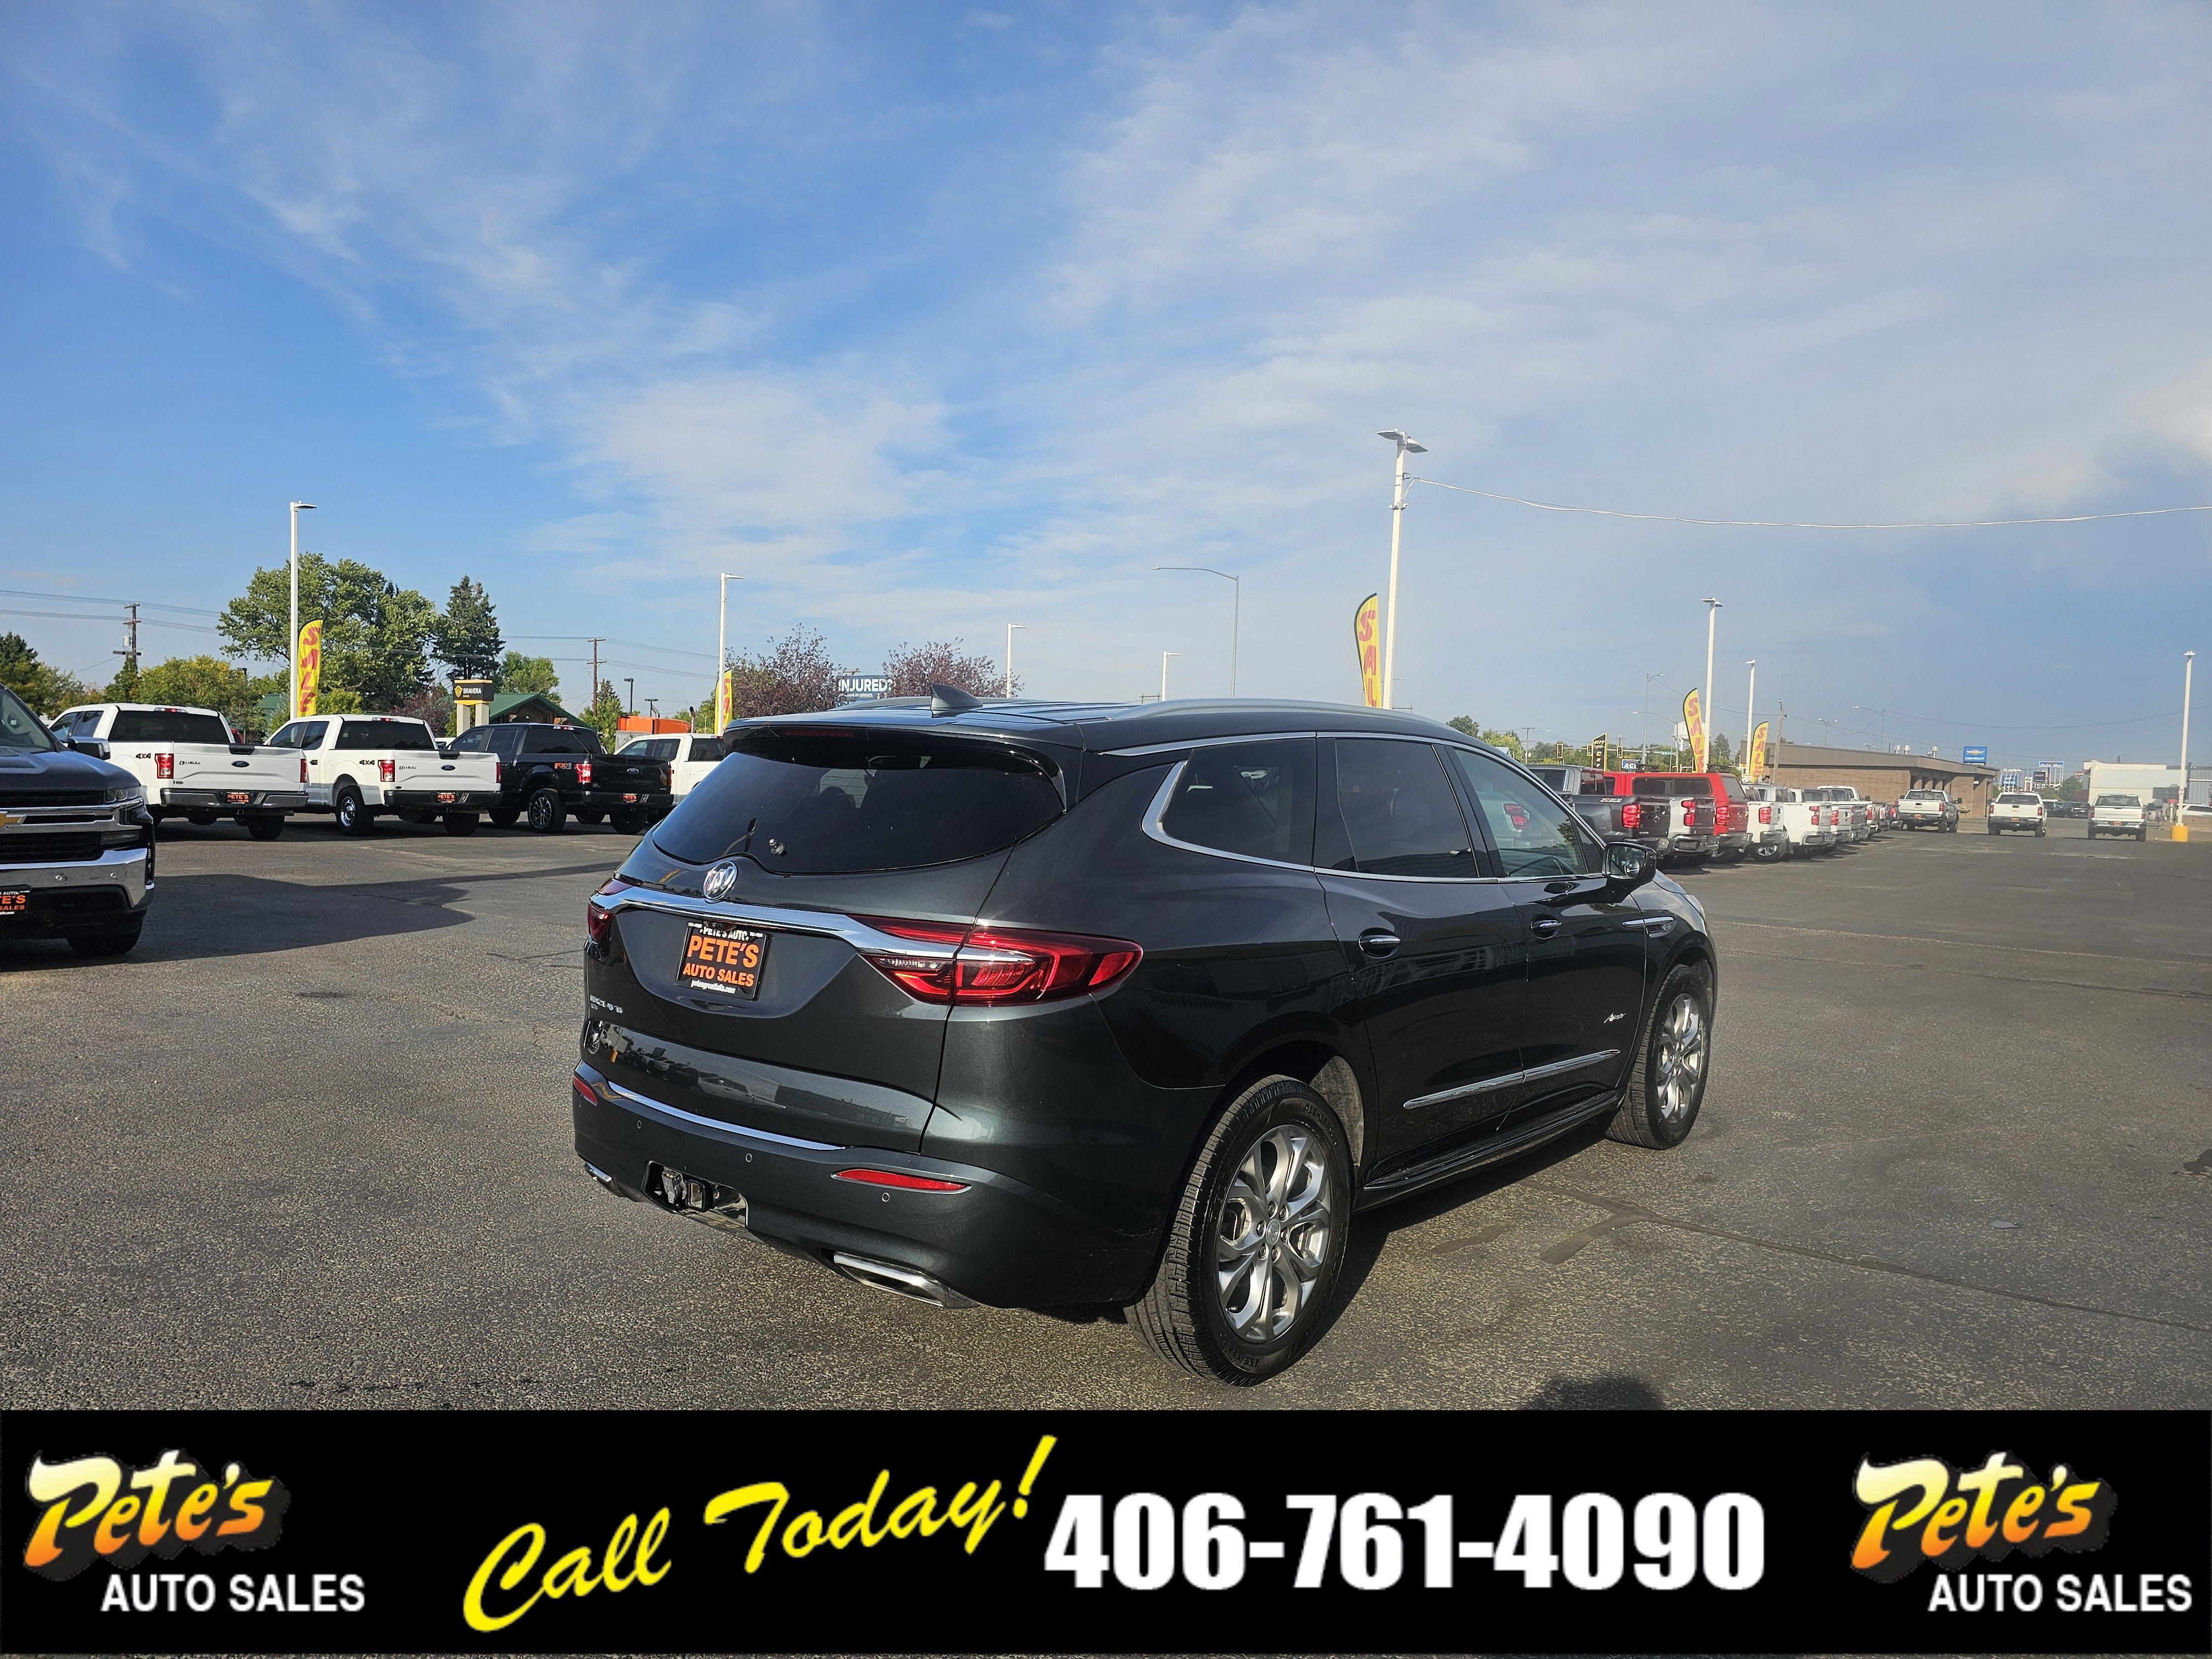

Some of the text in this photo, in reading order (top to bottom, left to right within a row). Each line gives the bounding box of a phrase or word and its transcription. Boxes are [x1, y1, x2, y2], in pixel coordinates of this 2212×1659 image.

[301, 627, 321, 713] SALE
[1358, 610, 1377, 707] SAL
[838, 679, 893, 692] INJURED?
[1752, 727, 1767, 778] SALE
[687, 935, 759, 968] PETE'S
[682, 963, 754, 987] AUTO SALES
[690, 979, 735, 994] petesgreatfalls.com
